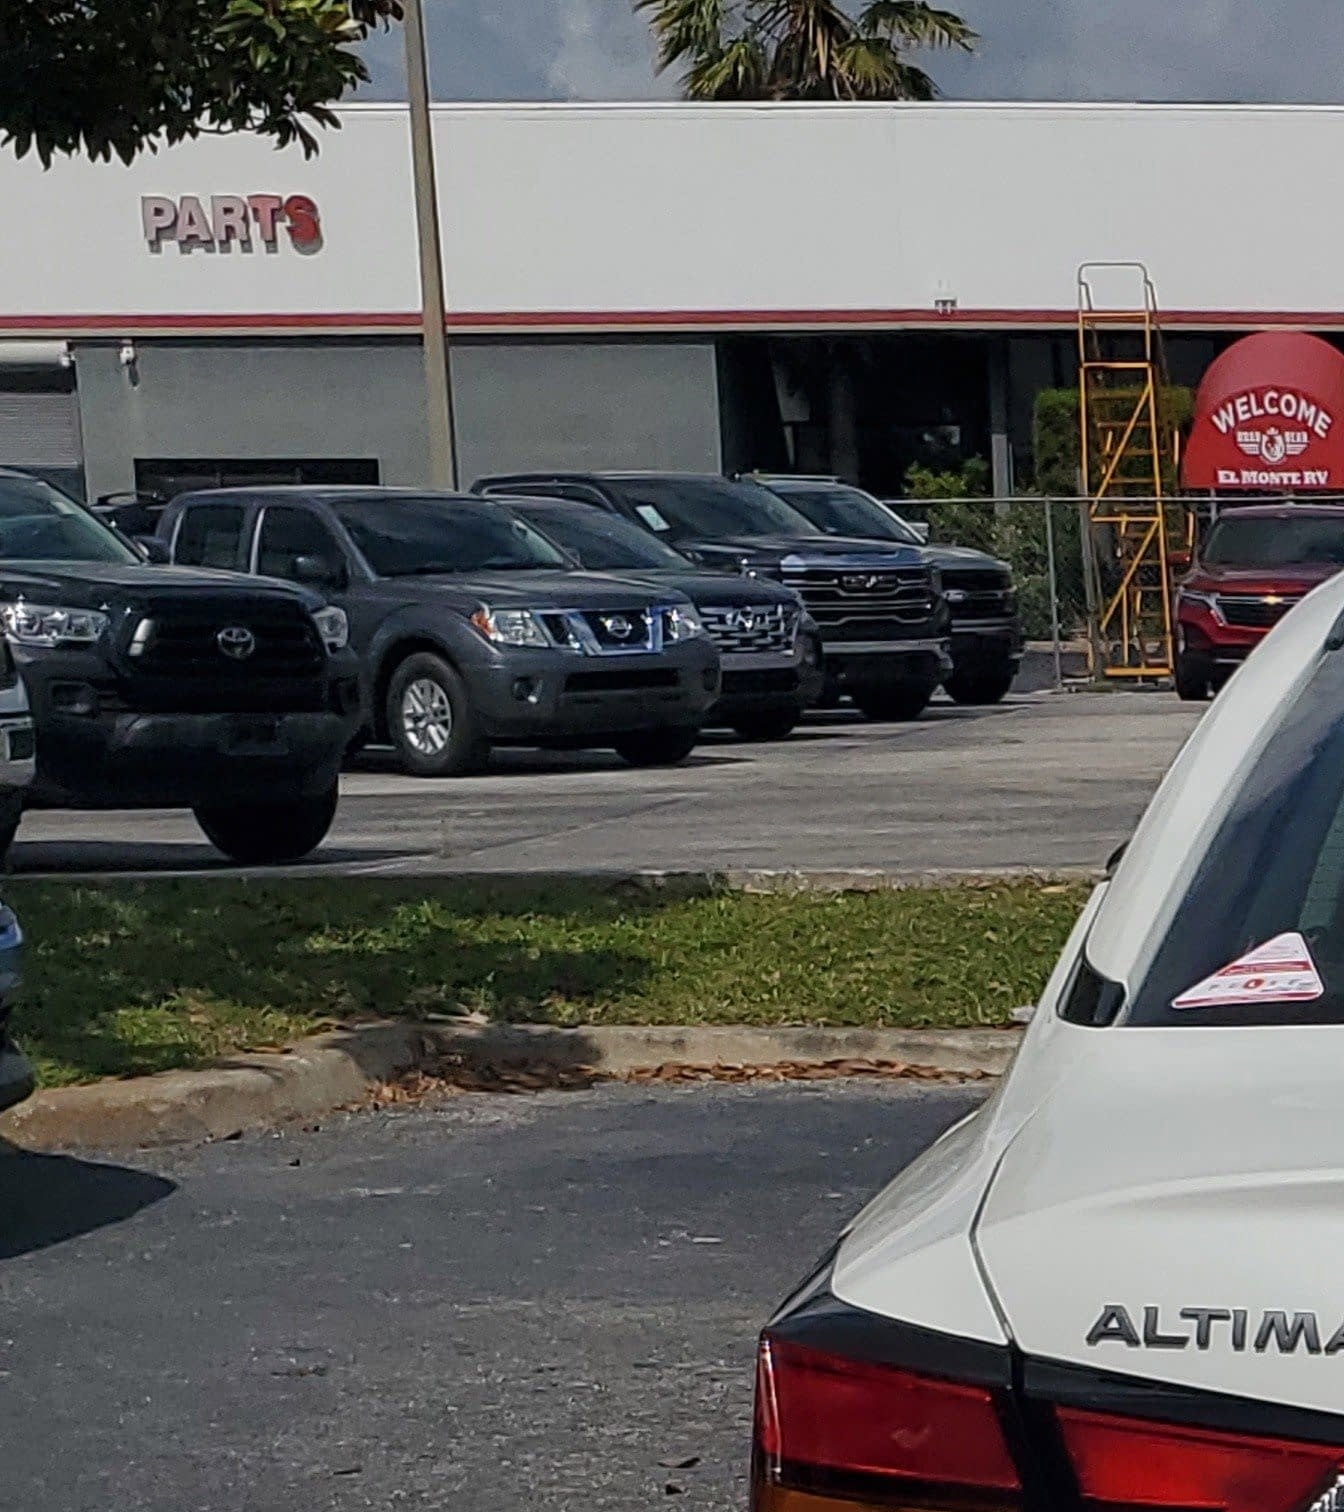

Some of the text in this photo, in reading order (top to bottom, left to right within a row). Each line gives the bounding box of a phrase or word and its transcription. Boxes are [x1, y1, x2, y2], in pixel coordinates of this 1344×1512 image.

[141, 194, 322, 254] PARTS
[1212, 391, 1331, 438] WELCOME
[1217, 469, 1328, 485] EL MONTE RV
